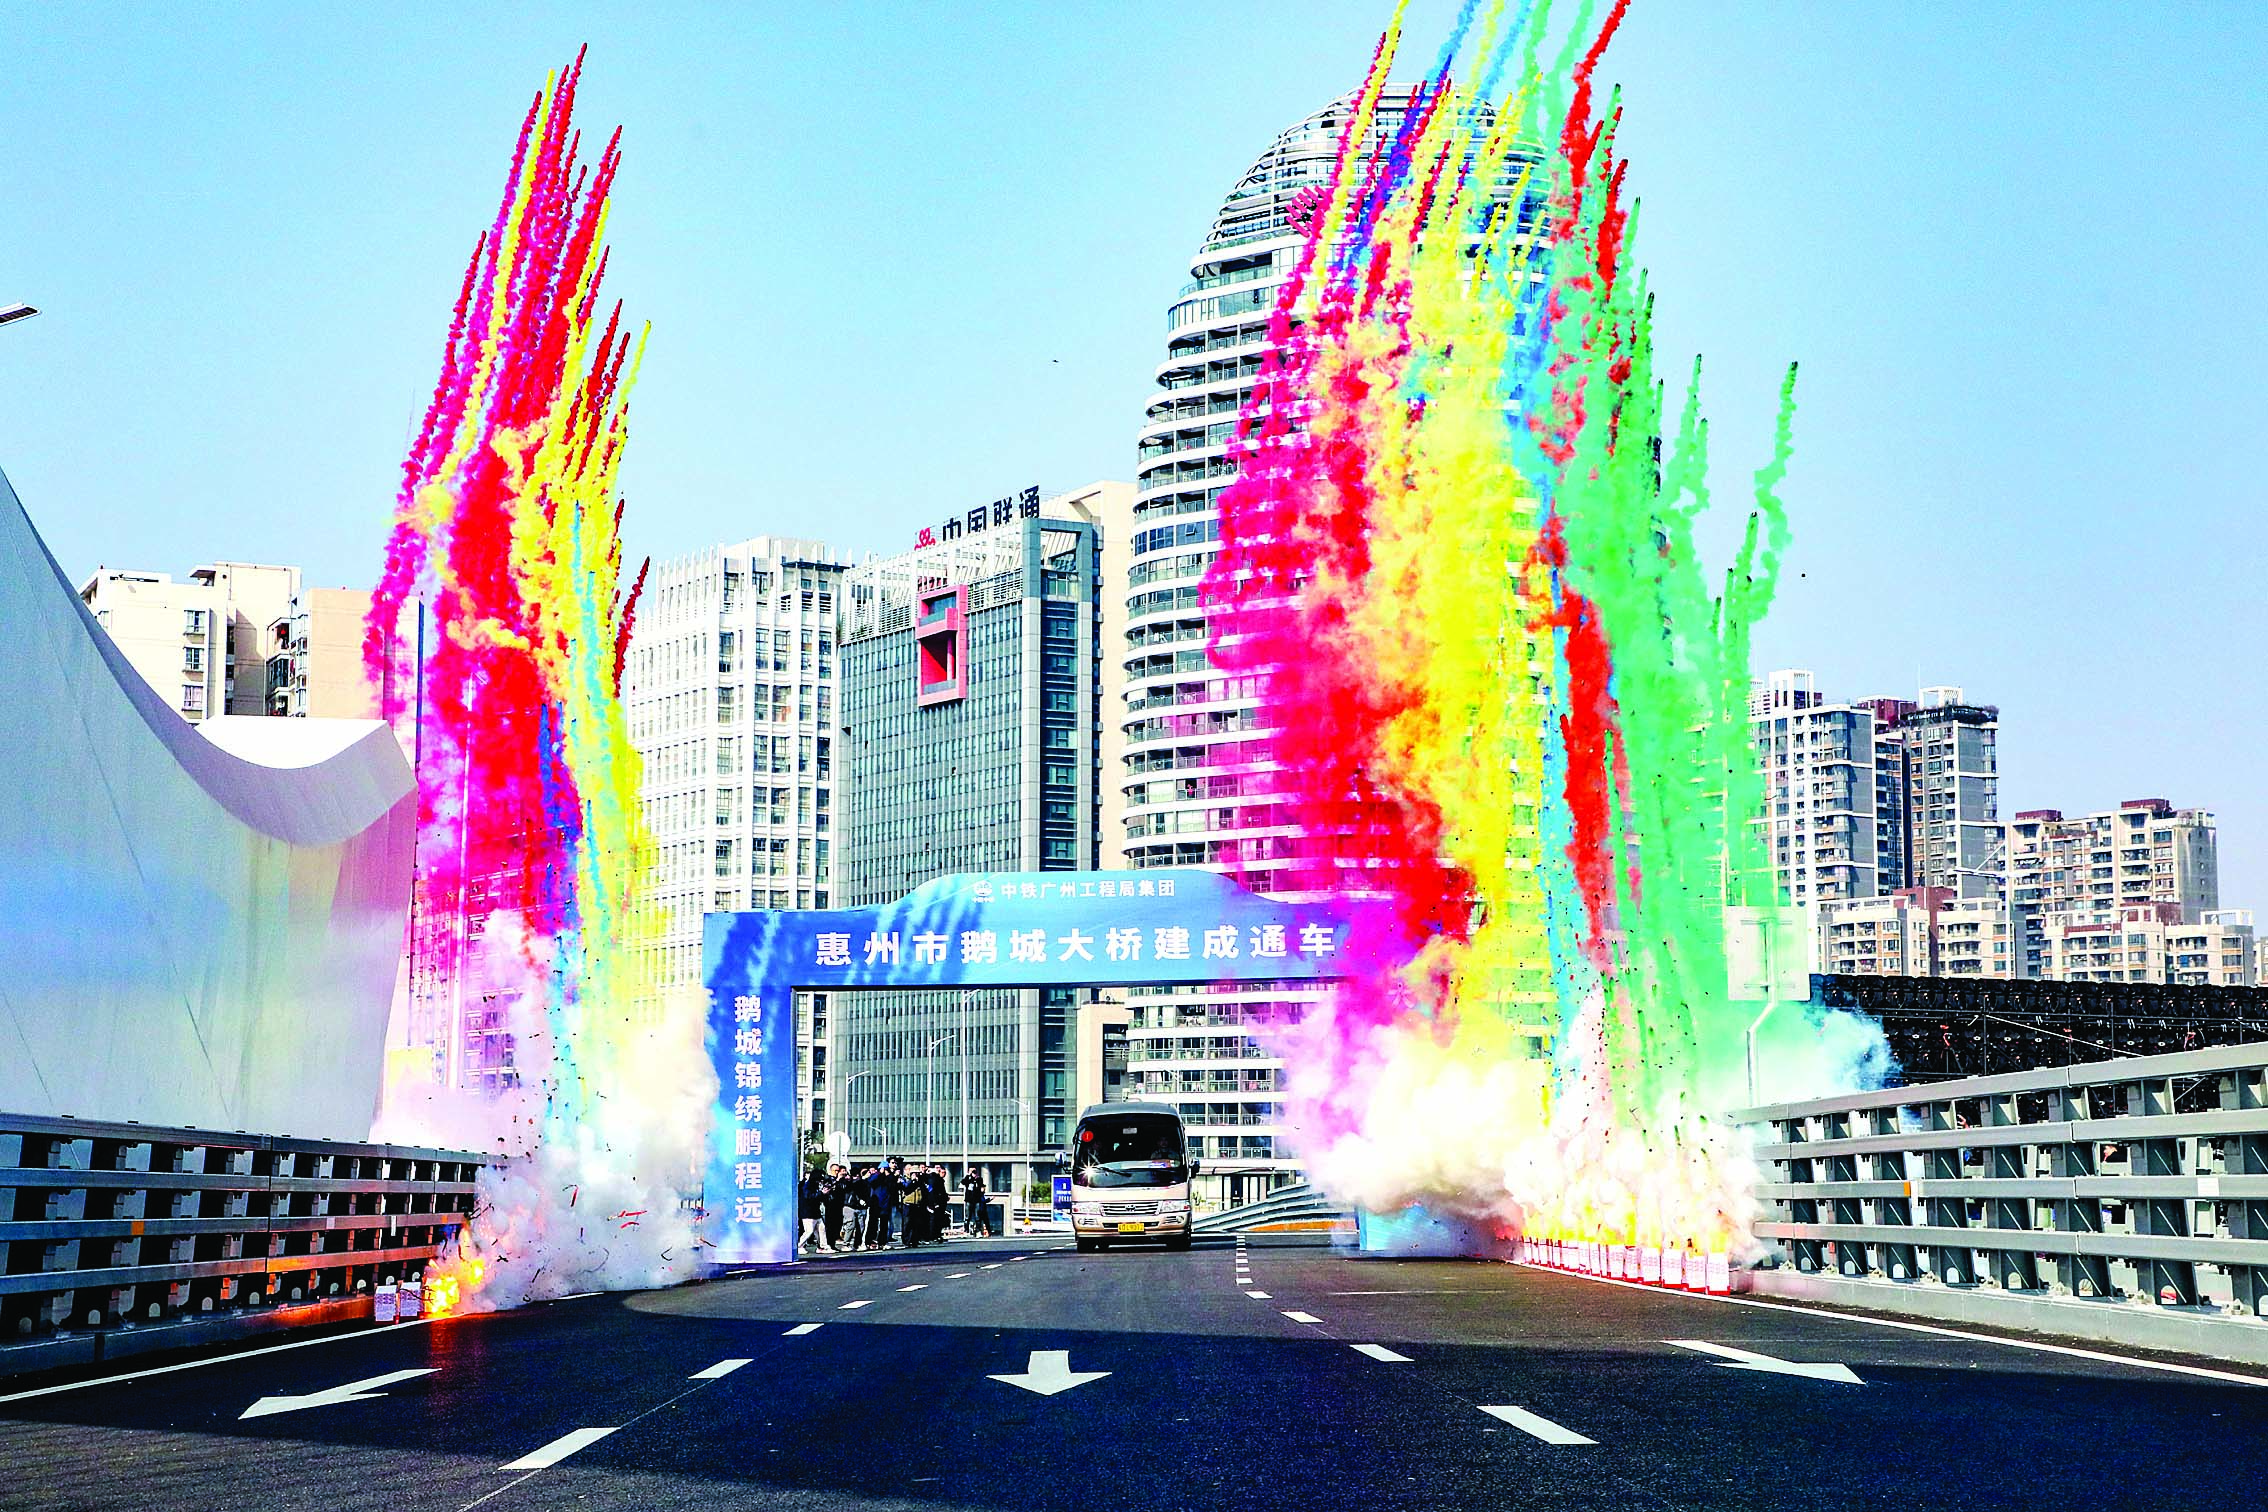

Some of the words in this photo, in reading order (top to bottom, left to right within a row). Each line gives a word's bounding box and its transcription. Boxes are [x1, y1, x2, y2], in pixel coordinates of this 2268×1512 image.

[942, 484, 1040, 542] 中国联通
[1001, 879, 1176, 899] 中铁广州工程局集团
[815, 922, 1335, 966] 惠州市鹅城大桥建成通车
[734, 995, 763, 1223] 鹅城锦绣鹏程远
